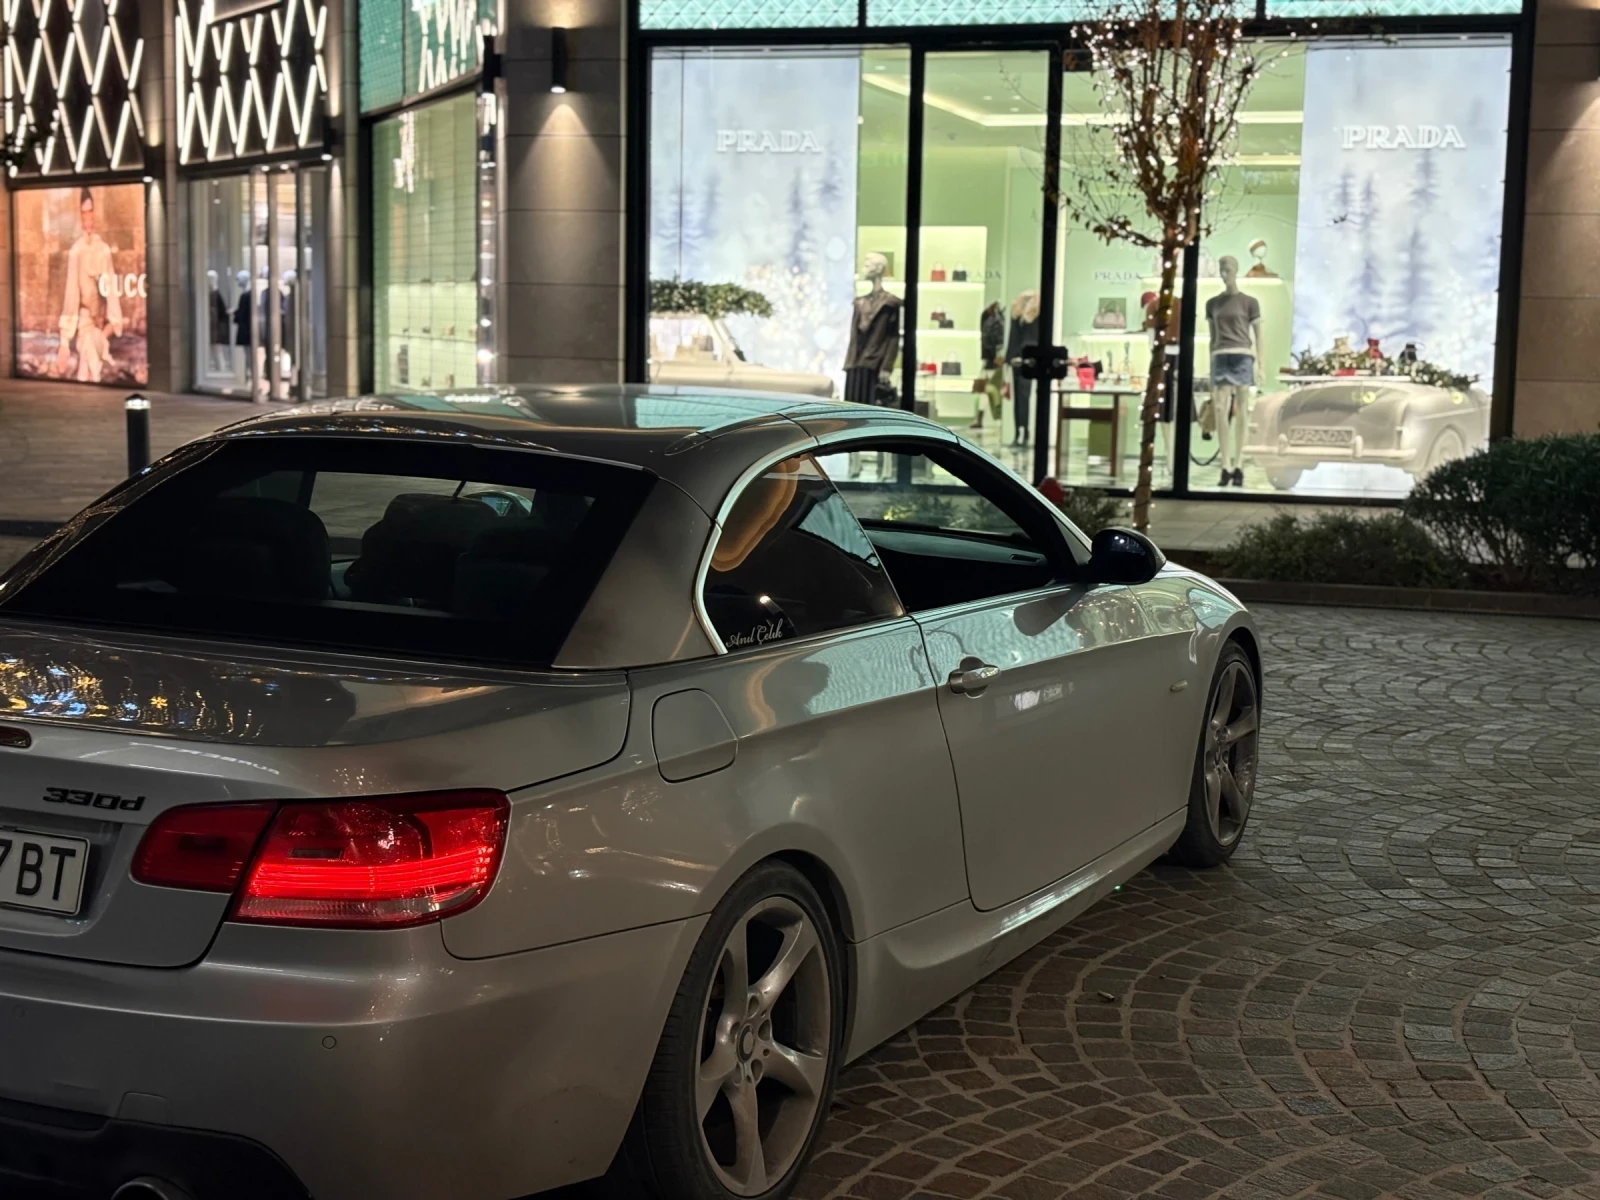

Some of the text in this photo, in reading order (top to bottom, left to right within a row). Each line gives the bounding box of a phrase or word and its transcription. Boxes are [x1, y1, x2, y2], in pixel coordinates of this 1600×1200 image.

[716, 130, 822, 153] PRADA
[1341, 124, 1467, 149] PRADA
[43, 787, 146, 811] 330d
